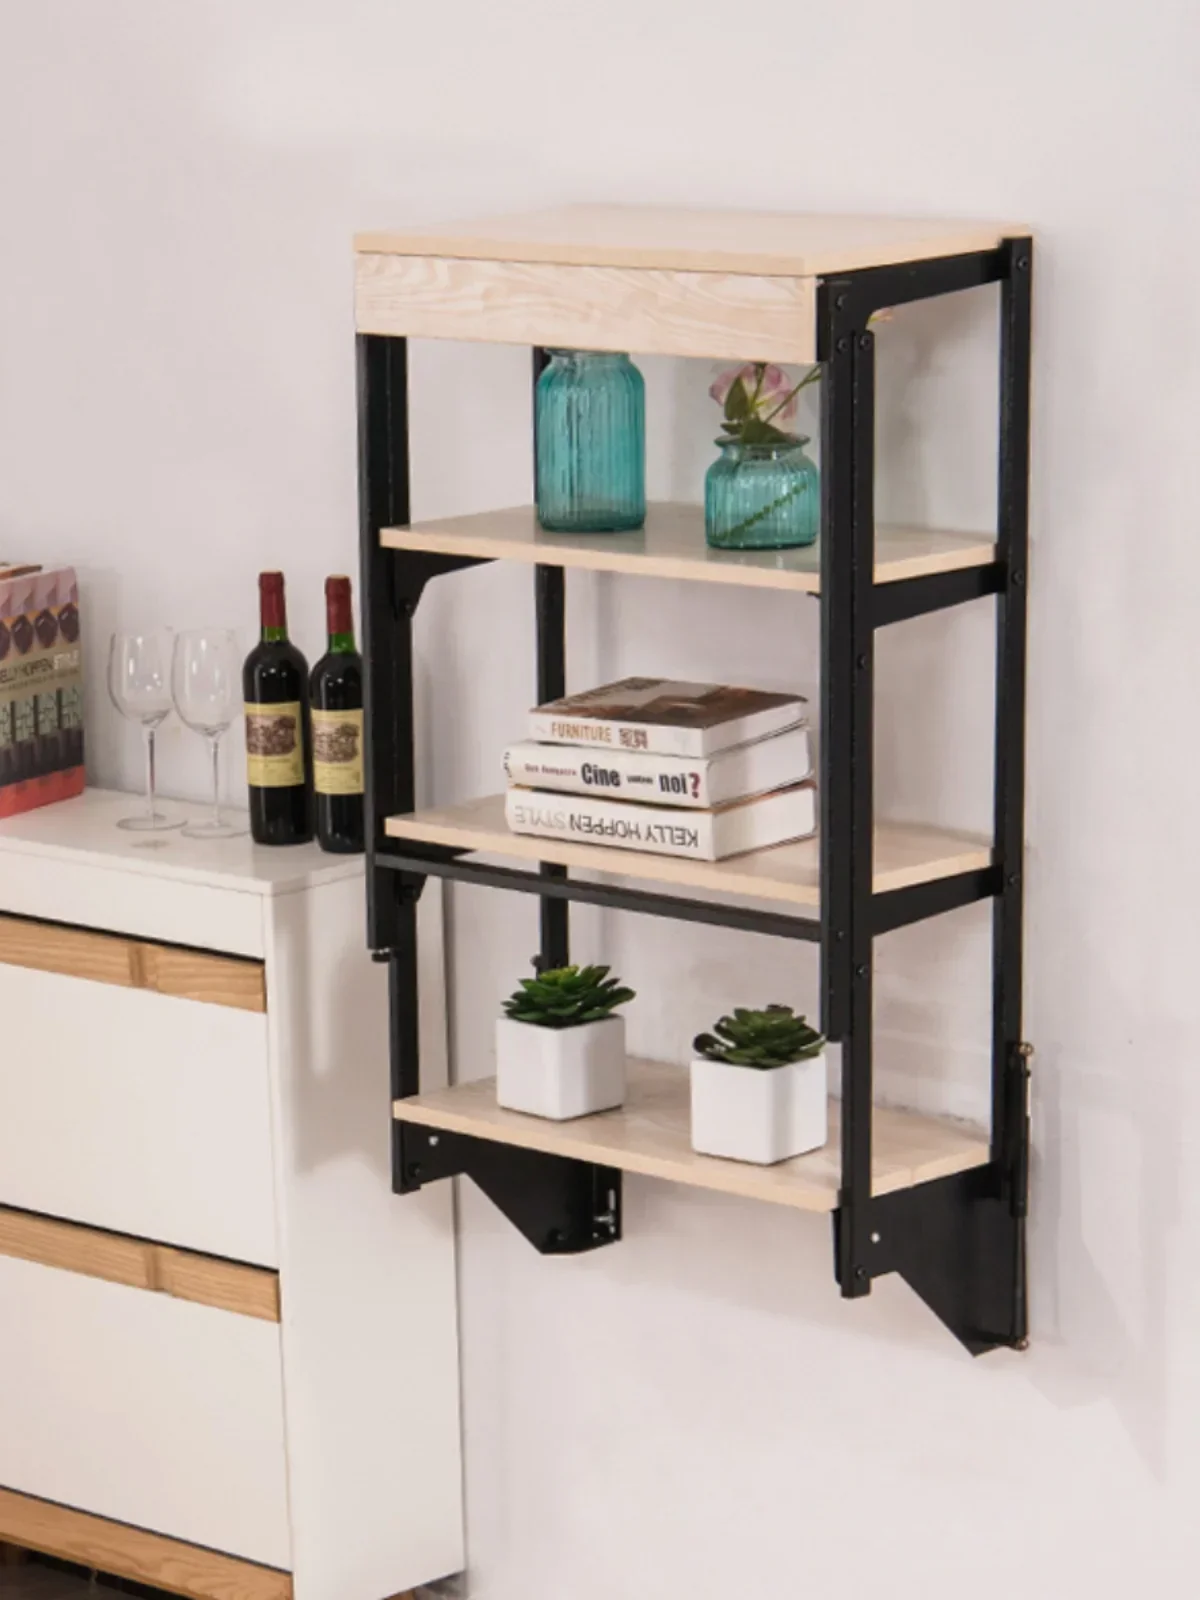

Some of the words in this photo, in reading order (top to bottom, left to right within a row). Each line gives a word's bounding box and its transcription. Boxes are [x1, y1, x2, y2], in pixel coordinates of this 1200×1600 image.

[551, 721, 612, 744] FURNITURE
[581, 762, 621, 787] Cine
[659, 771, 701, 799] noi?
[515, 804, 567, 830] STYLE
[569, 813, 641, 840] HOPPEN
[645, 824, 699, 848] KELLY
